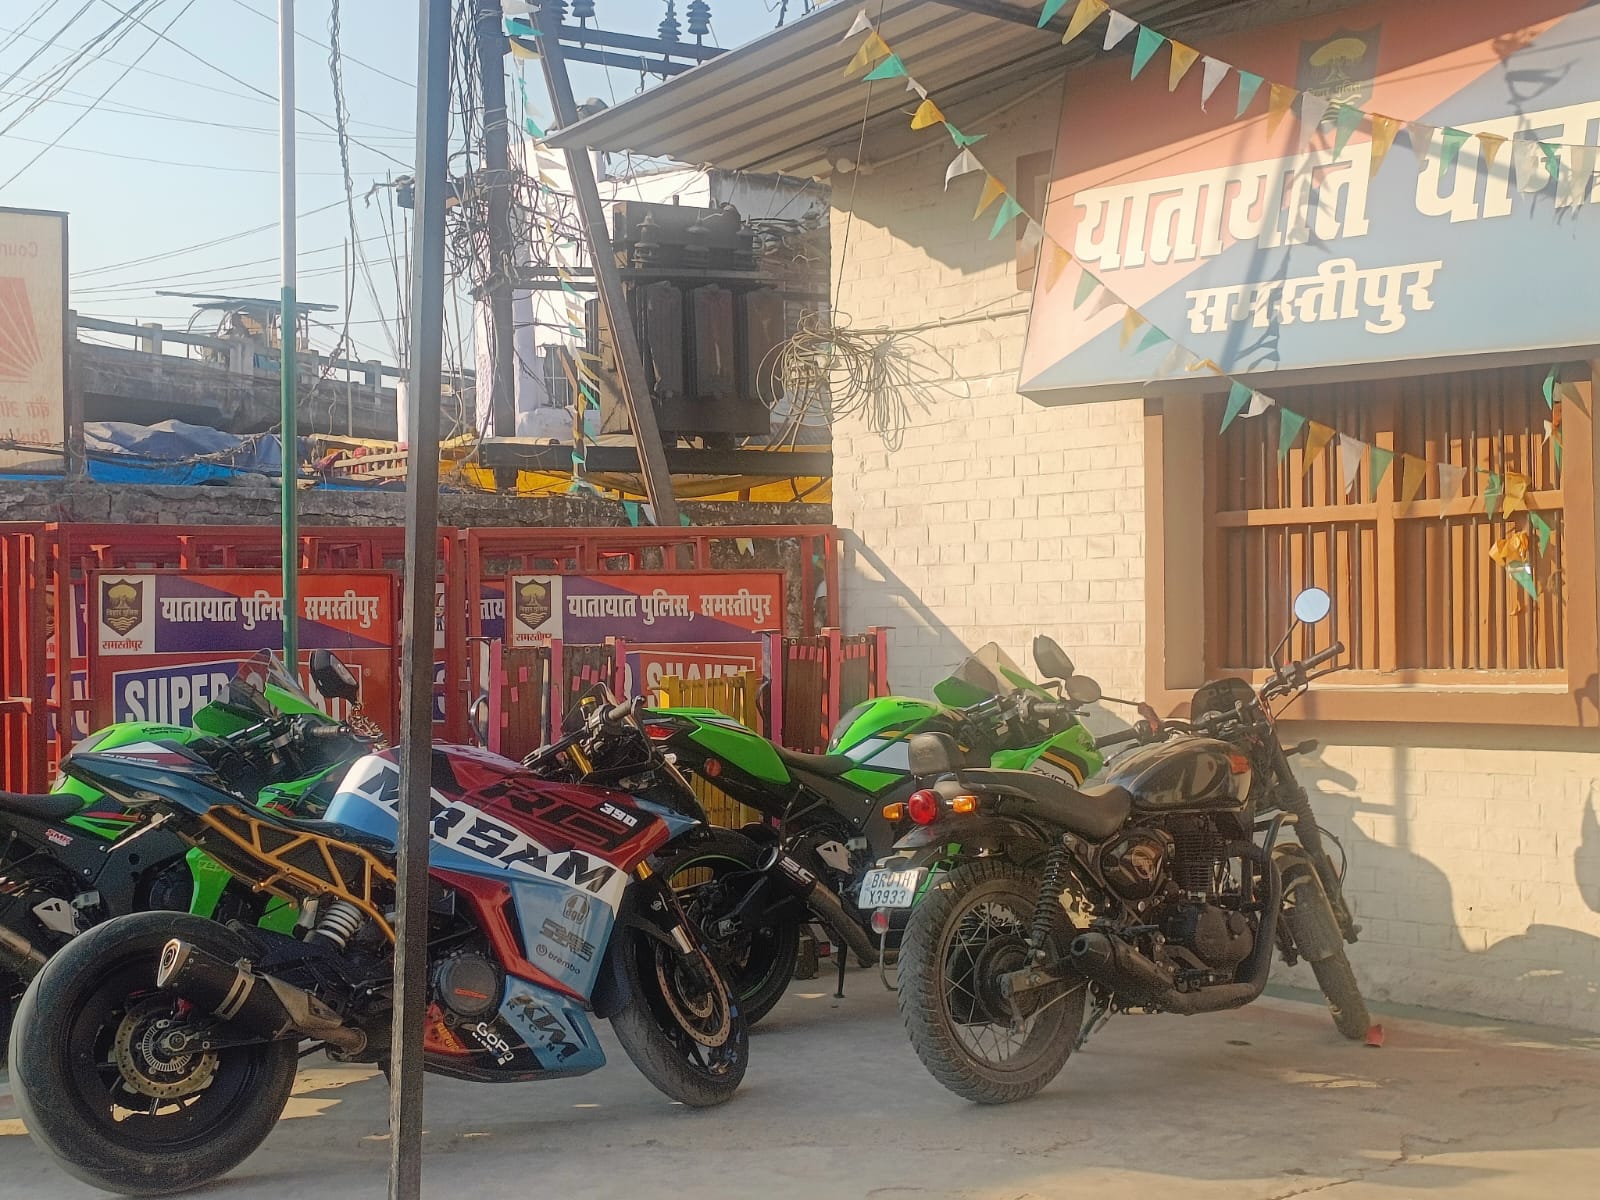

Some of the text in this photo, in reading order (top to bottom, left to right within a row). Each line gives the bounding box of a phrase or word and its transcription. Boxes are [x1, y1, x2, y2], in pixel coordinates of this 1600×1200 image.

[1073, 100, 1600, 272] यातायात थान
[1185, 257, 1443, 335] समस्तीपुर
[160, 597, 237, 622] यातायात
[304, 590, 379, 629] समस्तीपुर
[567, 589, 771, 625] यातायात पुलिस, समस्तीपुर
[102, 638, 143, 651] समस्तीपुर
[599, 802, 638, 828] 390
[869, 890, 906, 905] X3933
[548, 951, 580, 975] brembo
